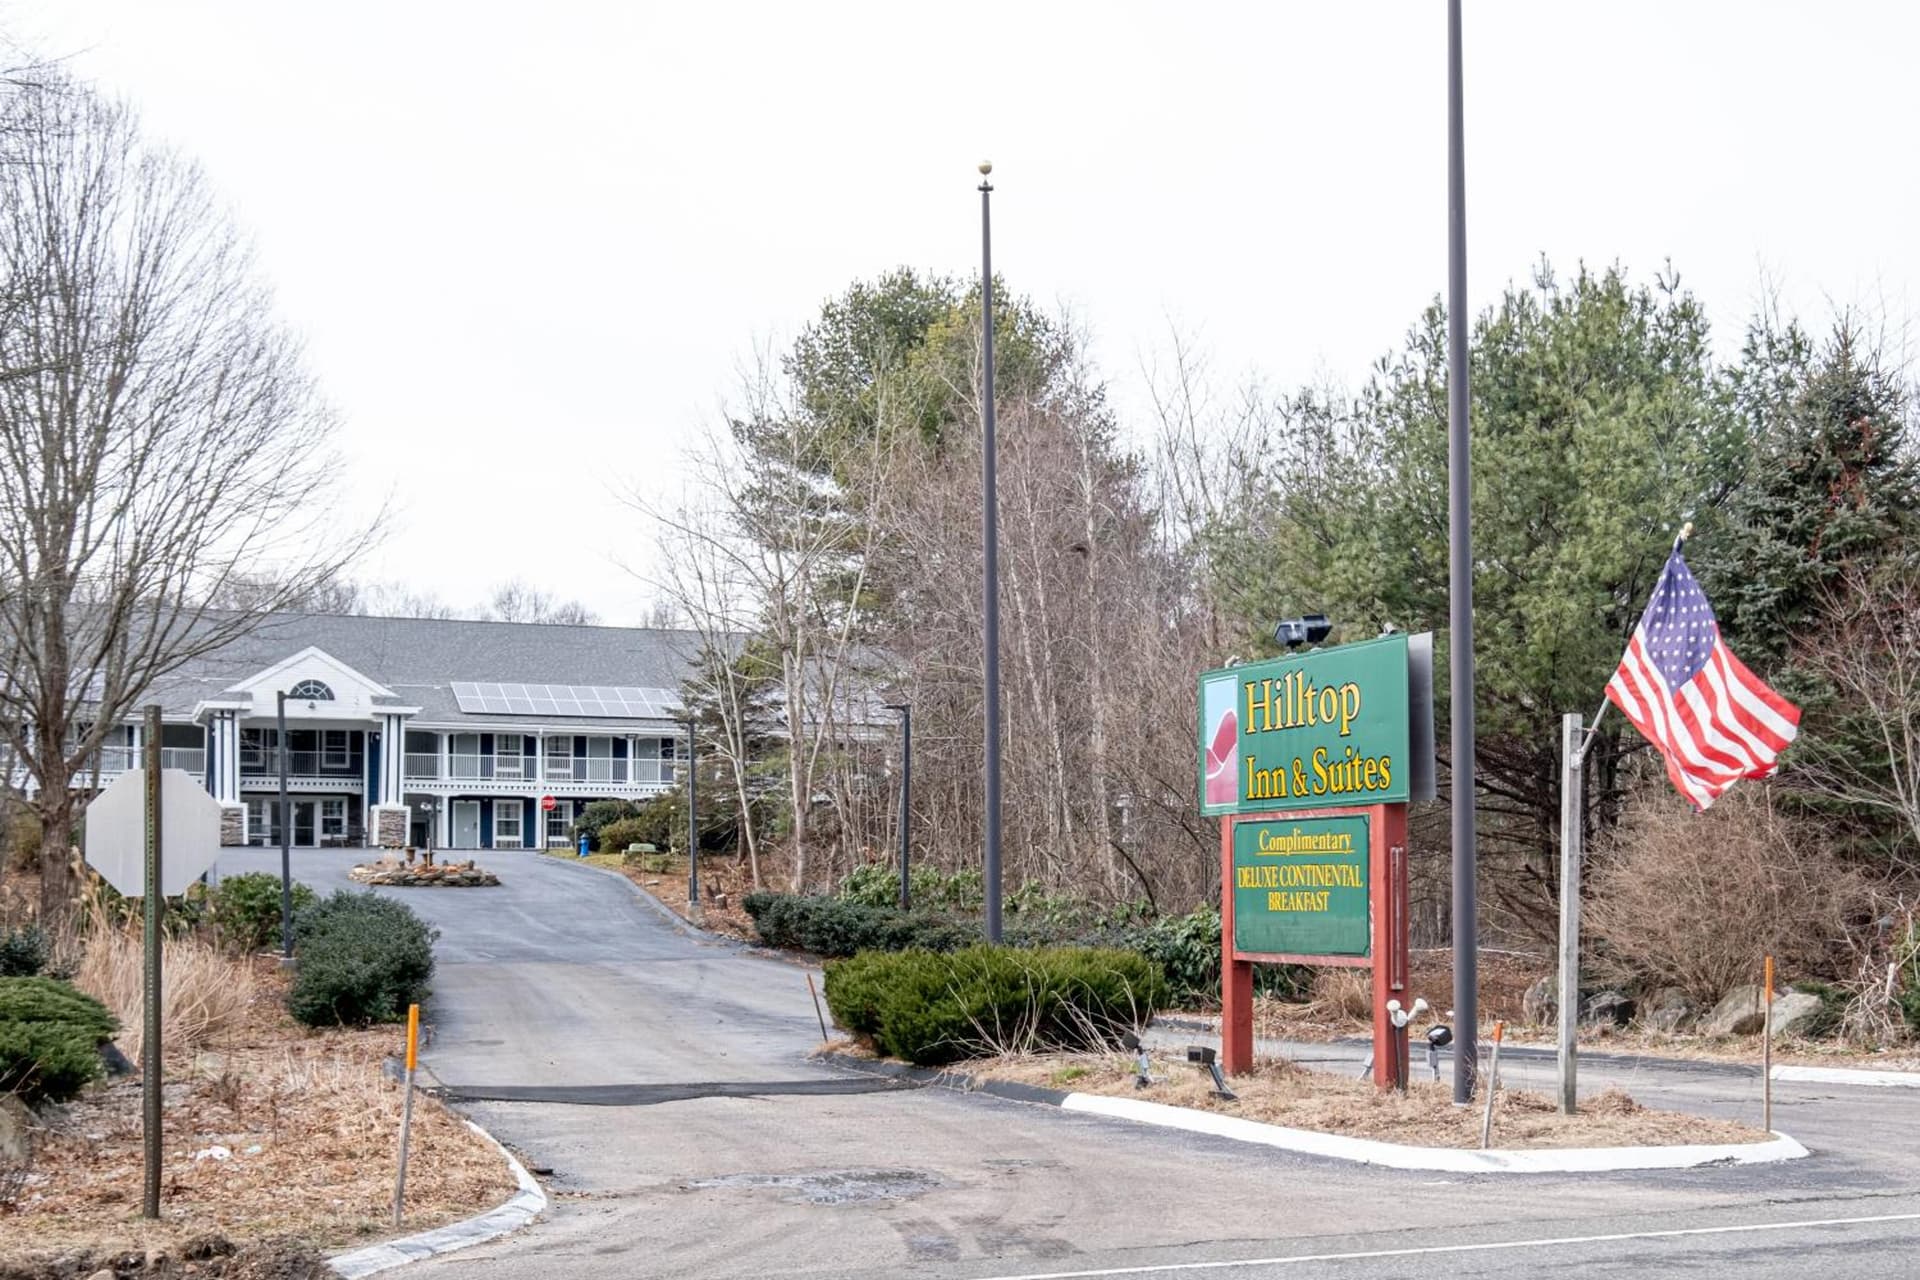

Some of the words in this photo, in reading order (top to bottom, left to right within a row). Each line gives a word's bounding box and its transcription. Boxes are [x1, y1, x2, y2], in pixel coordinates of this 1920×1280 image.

[1245, 669, 1361, 736] Hilltop
[1246, 756, 1288, 799] Inn
[1292, 757, 1310, 797] &
[1312, 746, 1392, 795] Suites
[1259, 828, 1352, 855] Complimentary
[1237, 866, 1279, 888] DELUXE
[1279, 864, 1363, 887] CONTINENTAL
[1268, 891, 1330, 911] BREAKFAST
